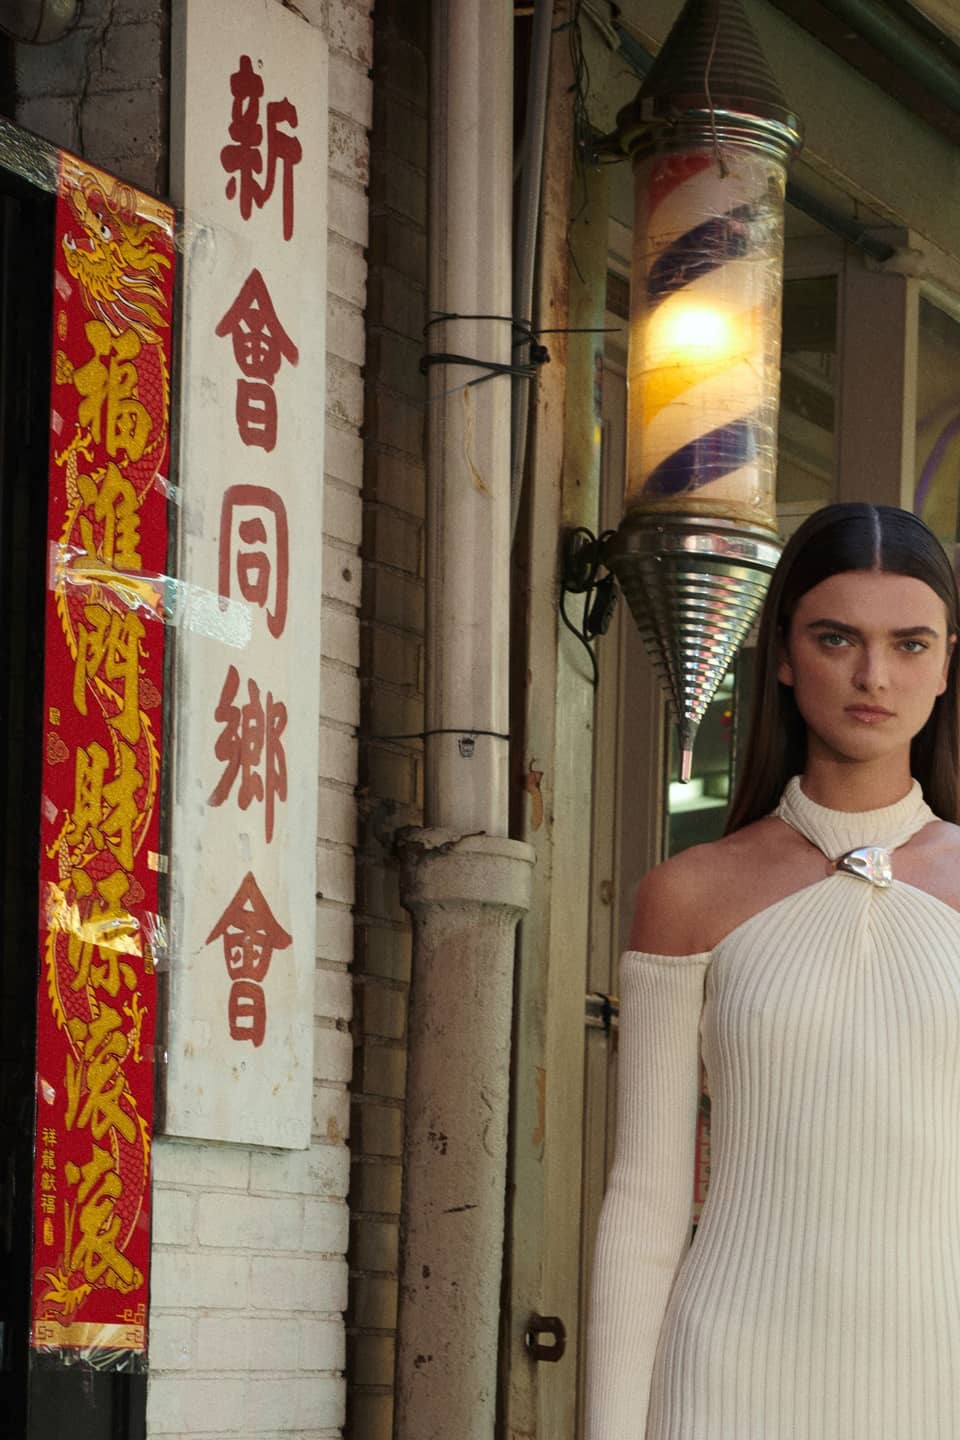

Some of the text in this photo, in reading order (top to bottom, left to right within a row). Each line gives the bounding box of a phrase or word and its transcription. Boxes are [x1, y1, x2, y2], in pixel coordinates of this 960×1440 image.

[206, 54, 303, 1047] 新會同鄉會
